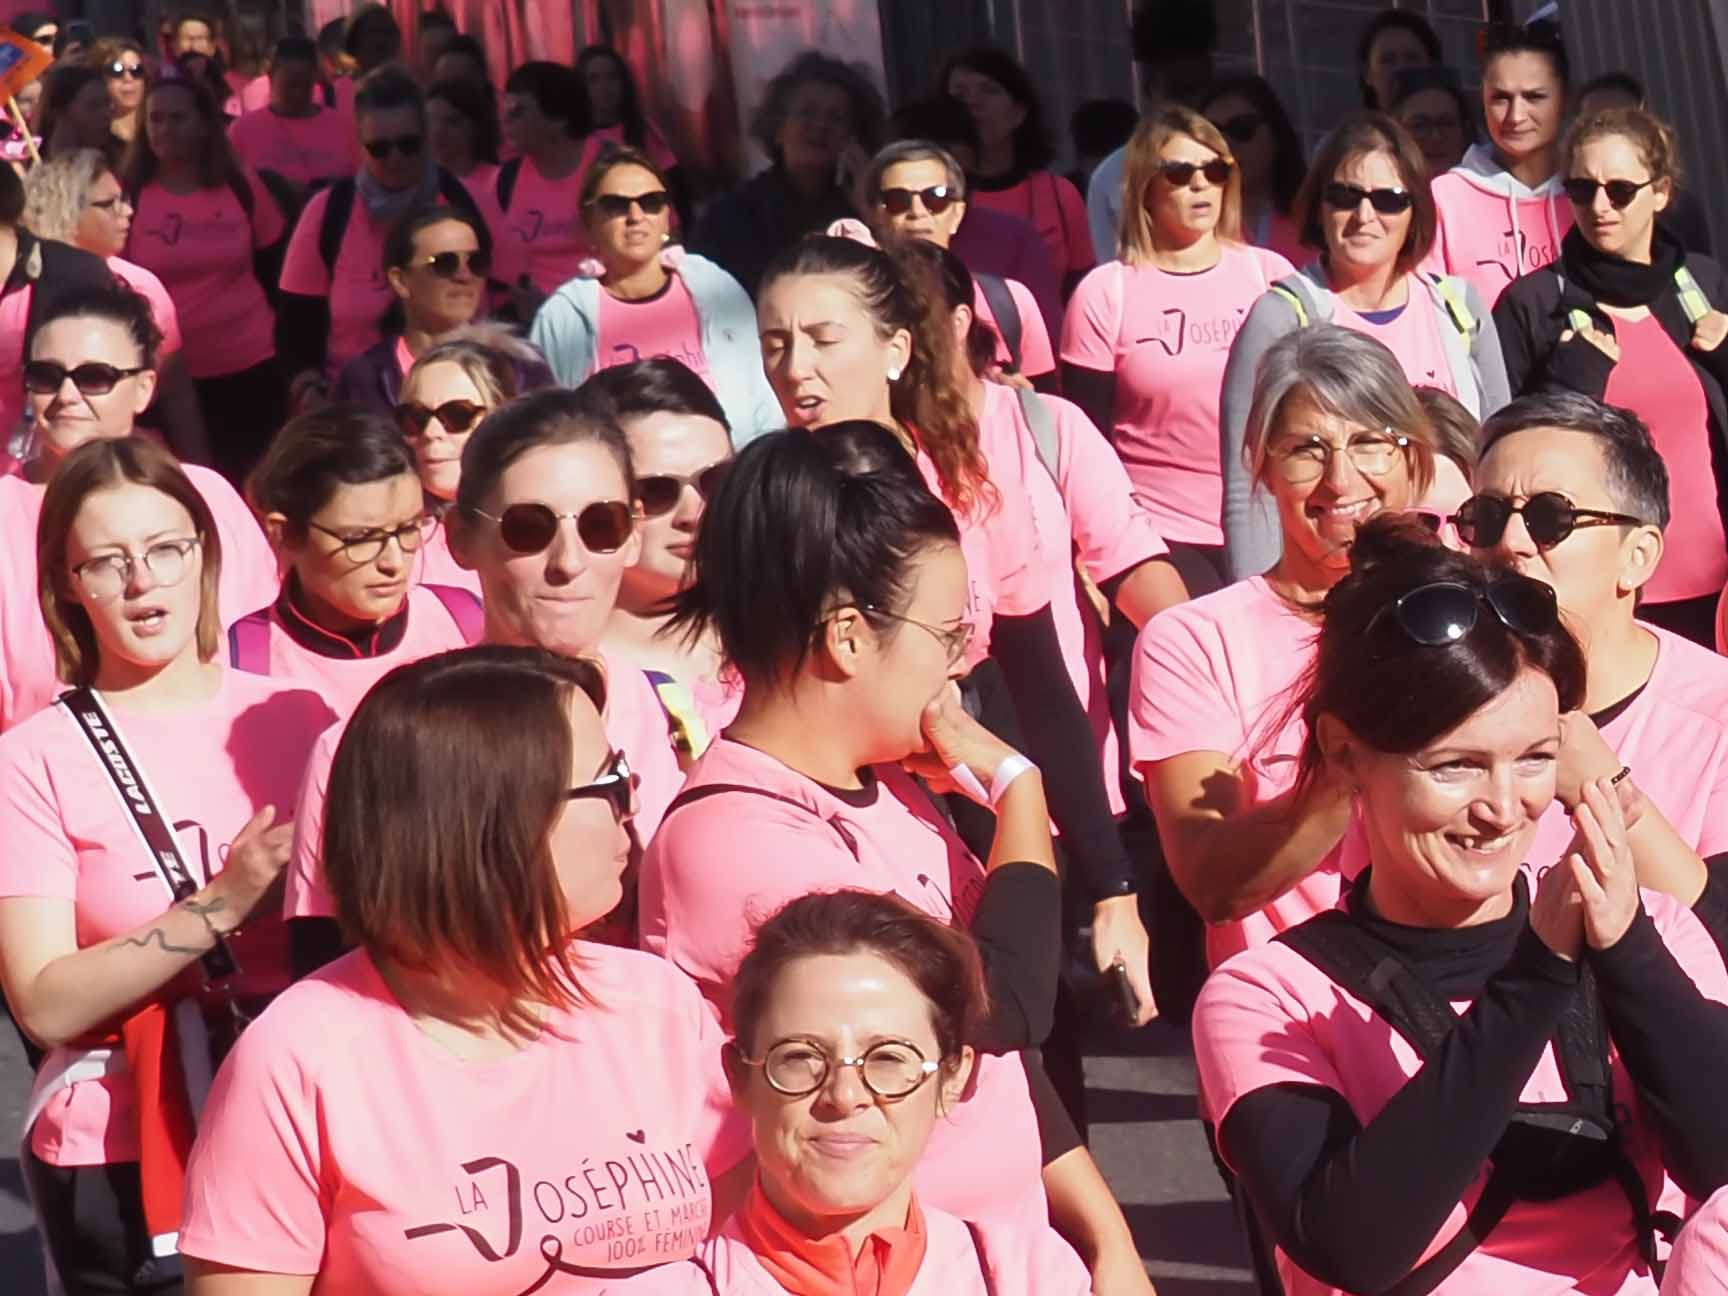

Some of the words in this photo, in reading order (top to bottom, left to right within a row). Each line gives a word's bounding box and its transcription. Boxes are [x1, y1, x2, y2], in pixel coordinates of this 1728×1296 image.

[455, 1182, 488, 1215] LA
[574, 1216, 635, 1247] COURSE
[644, 1210, 662, 1232] ET
